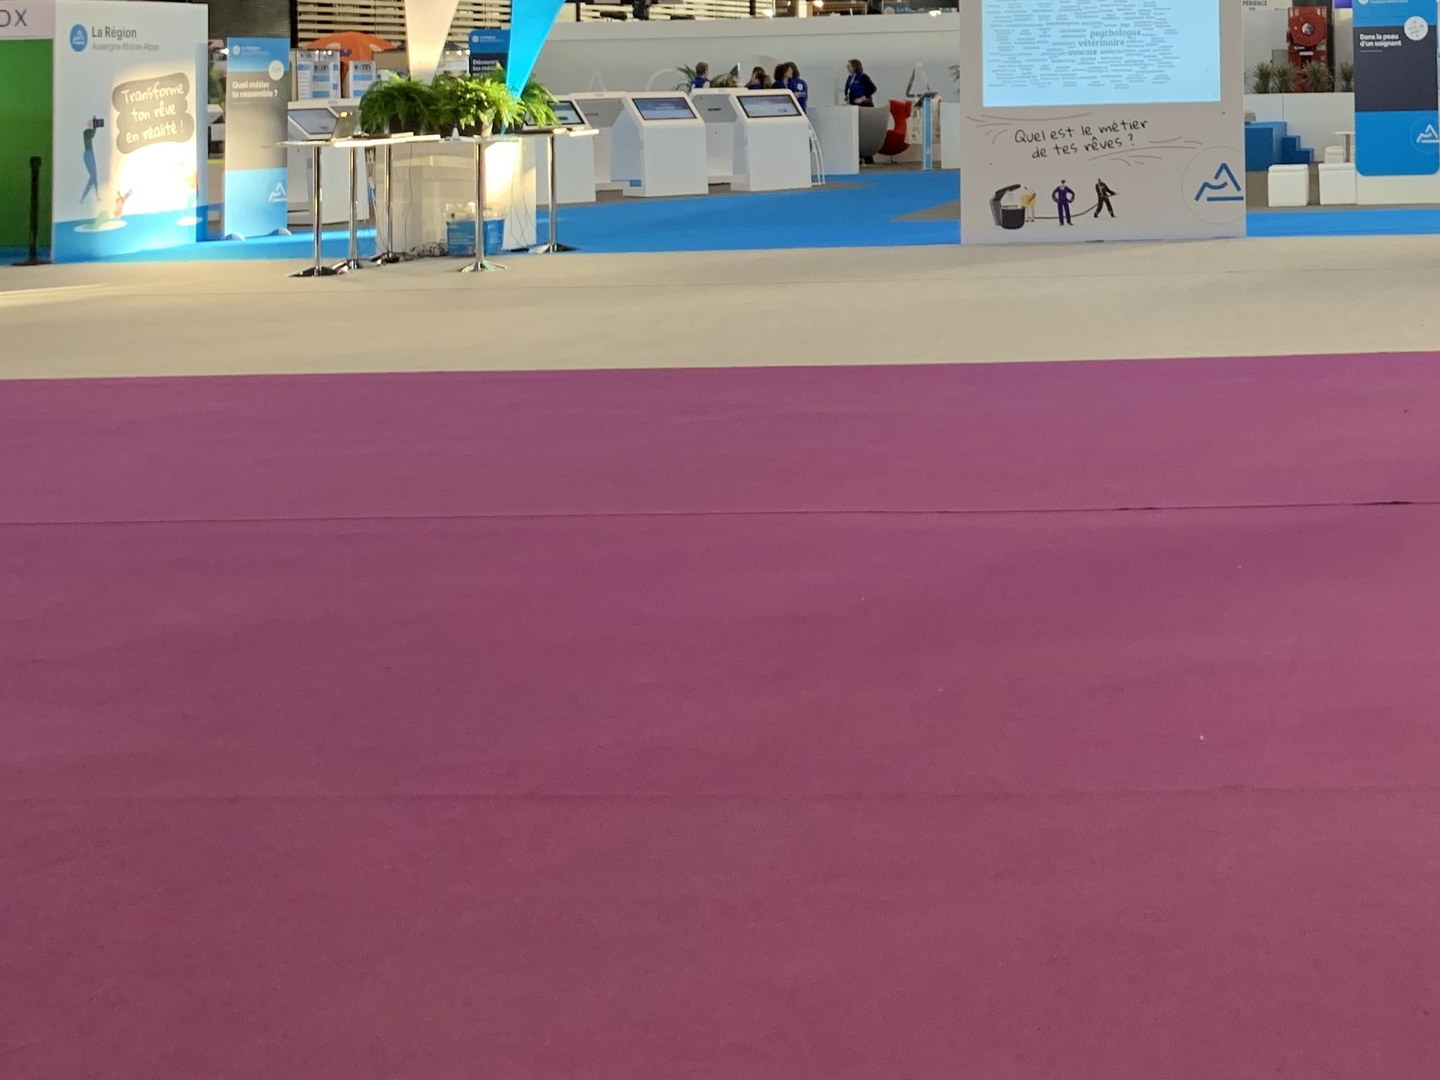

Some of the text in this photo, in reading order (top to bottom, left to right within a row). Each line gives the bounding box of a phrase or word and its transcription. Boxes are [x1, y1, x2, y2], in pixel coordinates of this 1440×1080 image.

[92, 25, 137, 40] La Région
[1090, 28, 1142, 39] psychologue
[1383, 34, 1399, 42] peau
[1078, 39, 1125, 47] vétérinaire
[1375, 40, 1402, 48] soignant
[1068, 48, 1097, 56] avocate
[232, 80, 270, 89] Quel métier
[121, 81, 184, 104] Transforme
[240, 90, 272, 98] ressemble
[131, 102, 176, 122] ton rêve
[126, 130, 139, 143] en
[143, 123, 177, 139] réalité
[1014, 119, 1148, 143] Quel est le métier
[1032, 134, 1134, 159] de tes rêves ?
